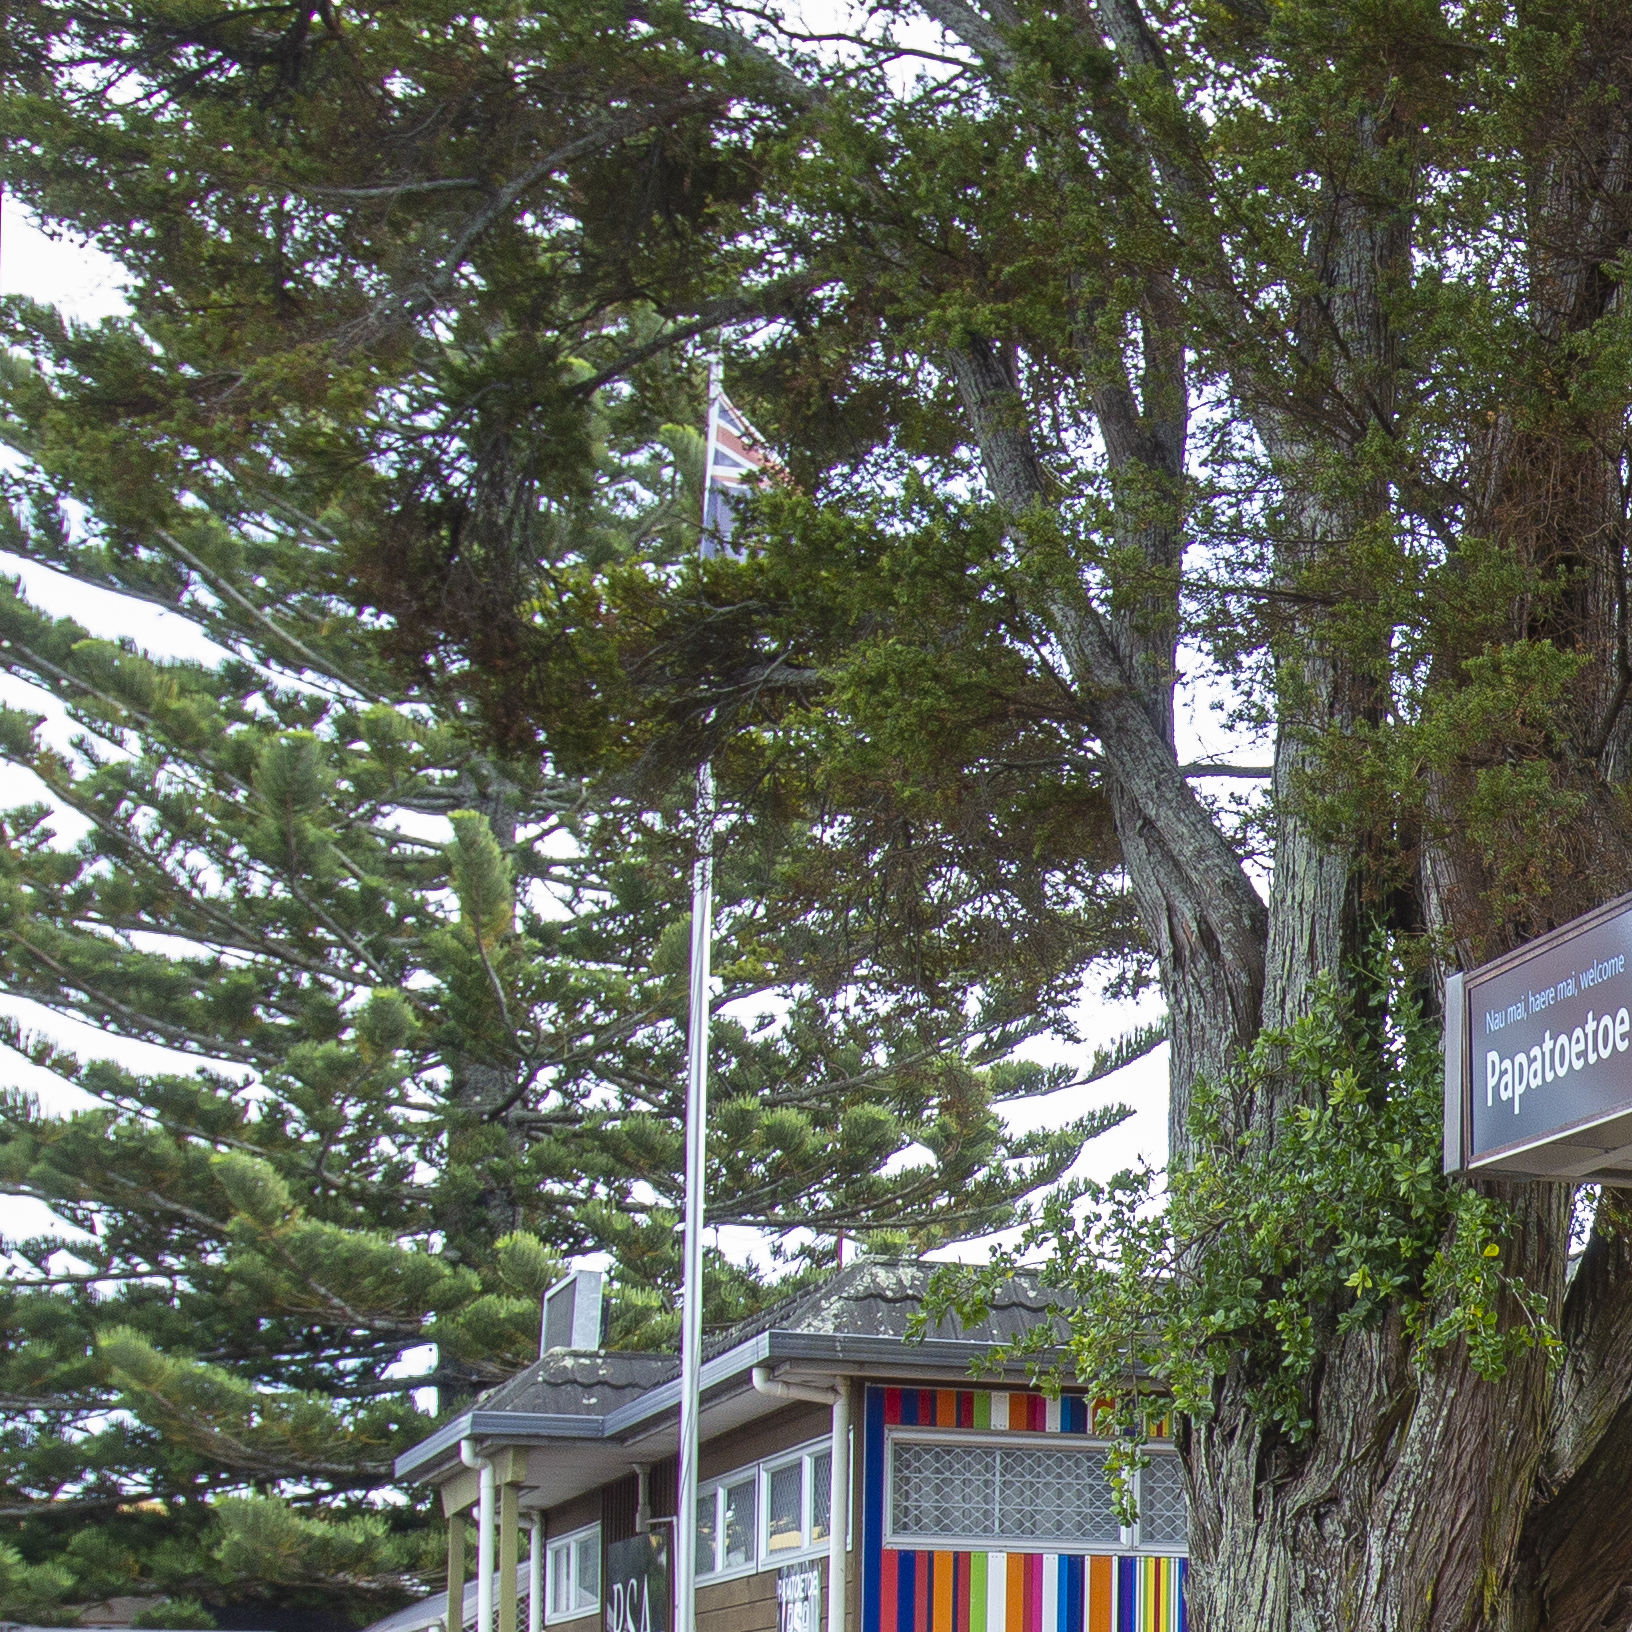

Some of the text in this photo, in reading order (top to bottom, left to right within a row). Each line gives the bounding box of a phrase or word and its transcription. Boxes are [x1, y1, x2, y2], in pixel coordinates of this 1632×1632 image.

[1485, 953, 1625, 1035] Nau mai, haere mai, welcome
[1486, 1007, 1630, 1114] Papatoetoe
